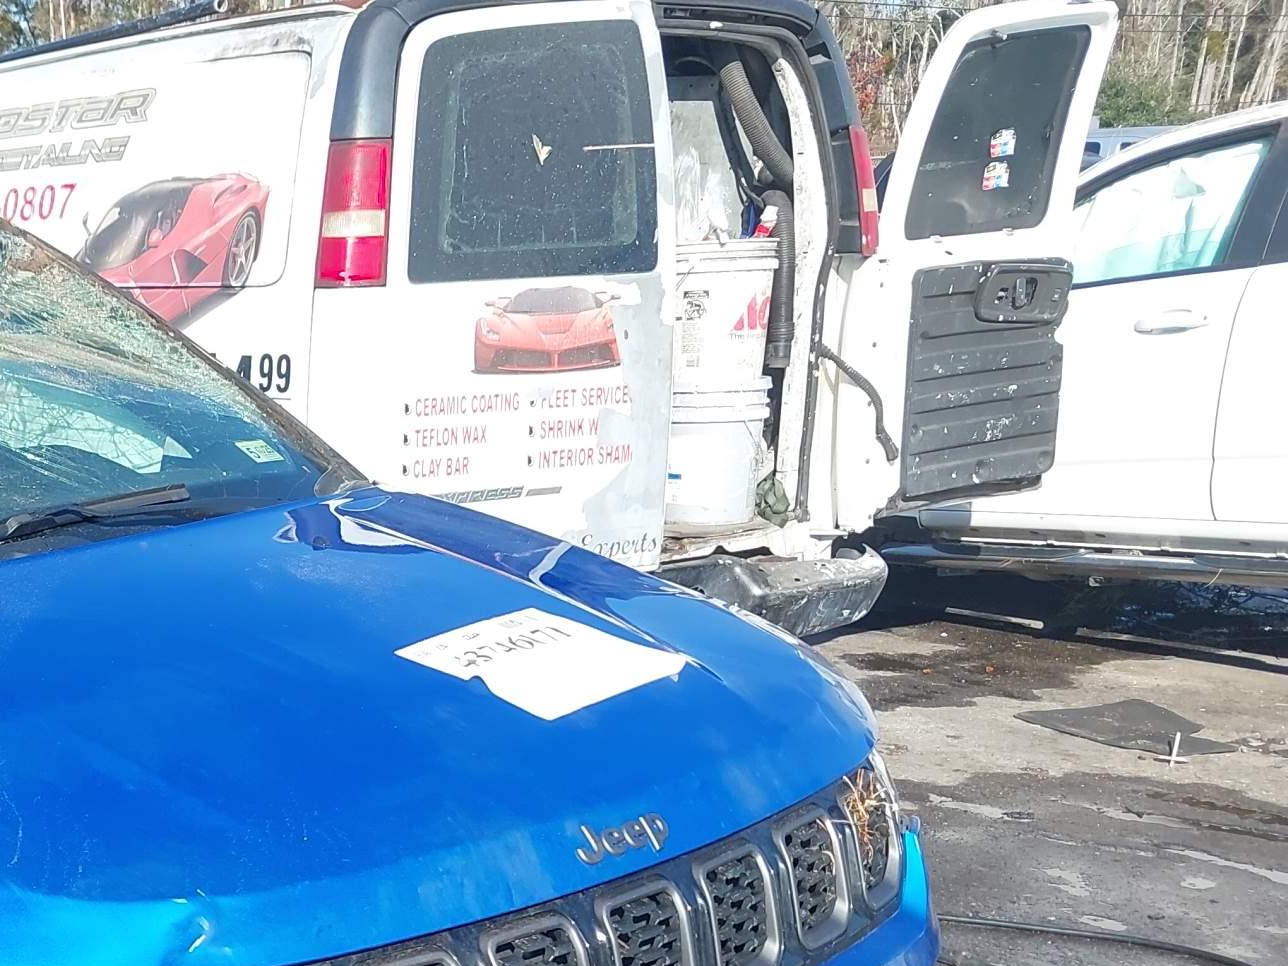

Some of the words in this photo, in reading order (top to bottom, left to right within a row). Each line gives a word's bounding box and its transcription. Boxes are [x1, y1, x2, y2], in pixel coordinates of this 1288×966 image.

[415, 396, 468, 417] CERAMIC
[471, 392, 520, 413] COATING
[415, 428, 458, 448] TEFLON
[462, 424, 487, 444] WAX
[540, 418, 584, 439] SHRINK
[413, 457, 442, 478] CLAY
[445, 456, 470, 476] BAR
[538, 447, 594, 469] INTERIOR
[598, 444, 632, 464] SHAM
[575, 812, 669, 865] Jeep
